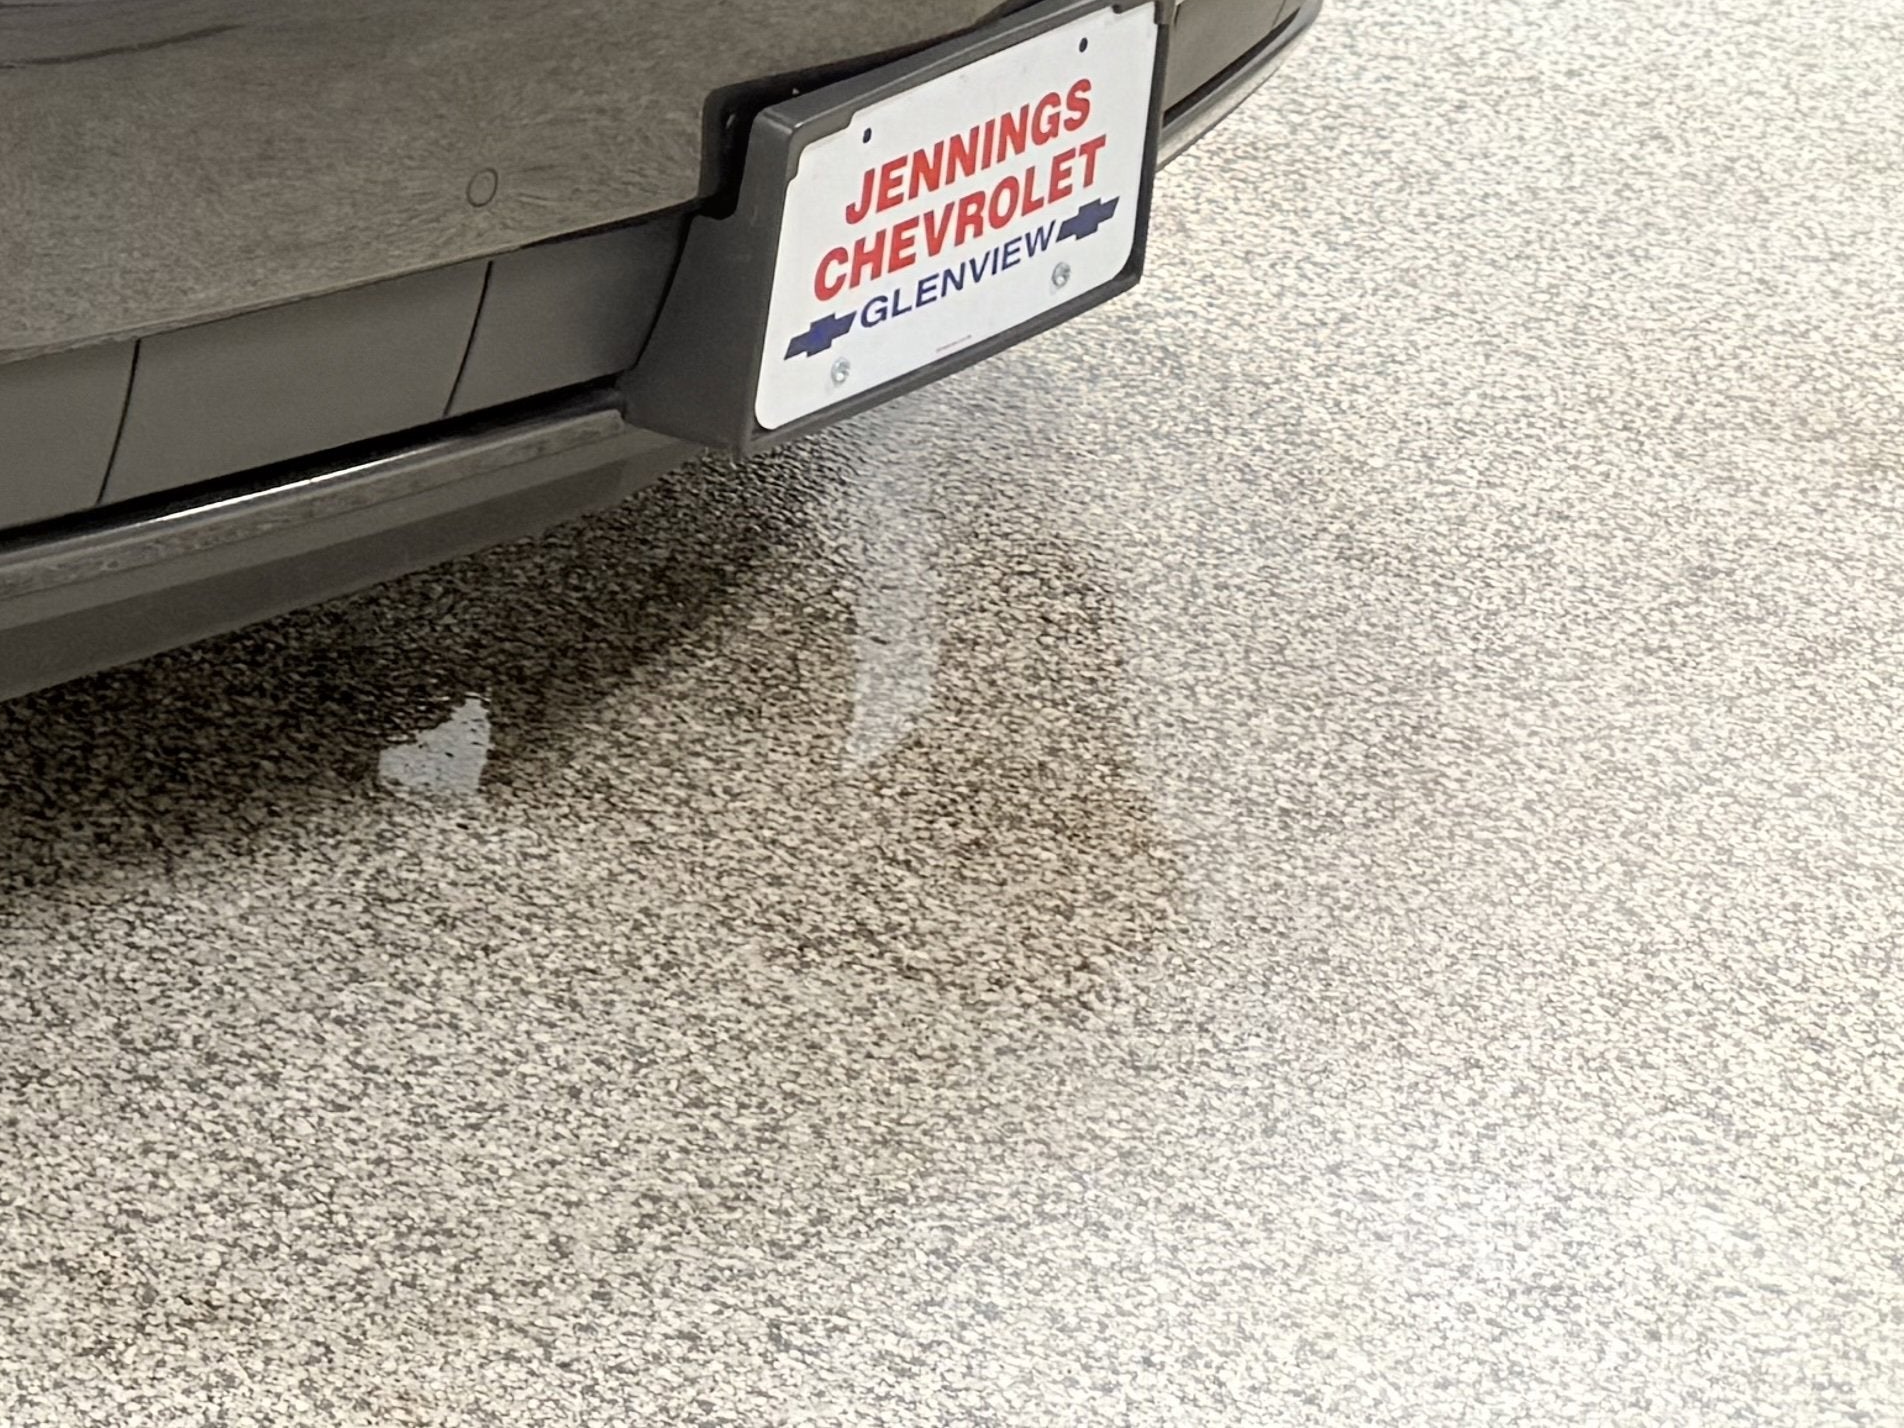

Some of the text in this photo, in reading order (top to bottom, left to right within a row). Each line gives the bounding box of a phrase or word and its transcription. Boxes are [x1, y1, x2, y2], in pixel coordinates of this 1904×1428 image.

[814, 134, 1107, 302] CHEVROLET
[845, 78, 1092, 225] JENNINGS
[860, 220, 1057, 328] GLENVIEW
